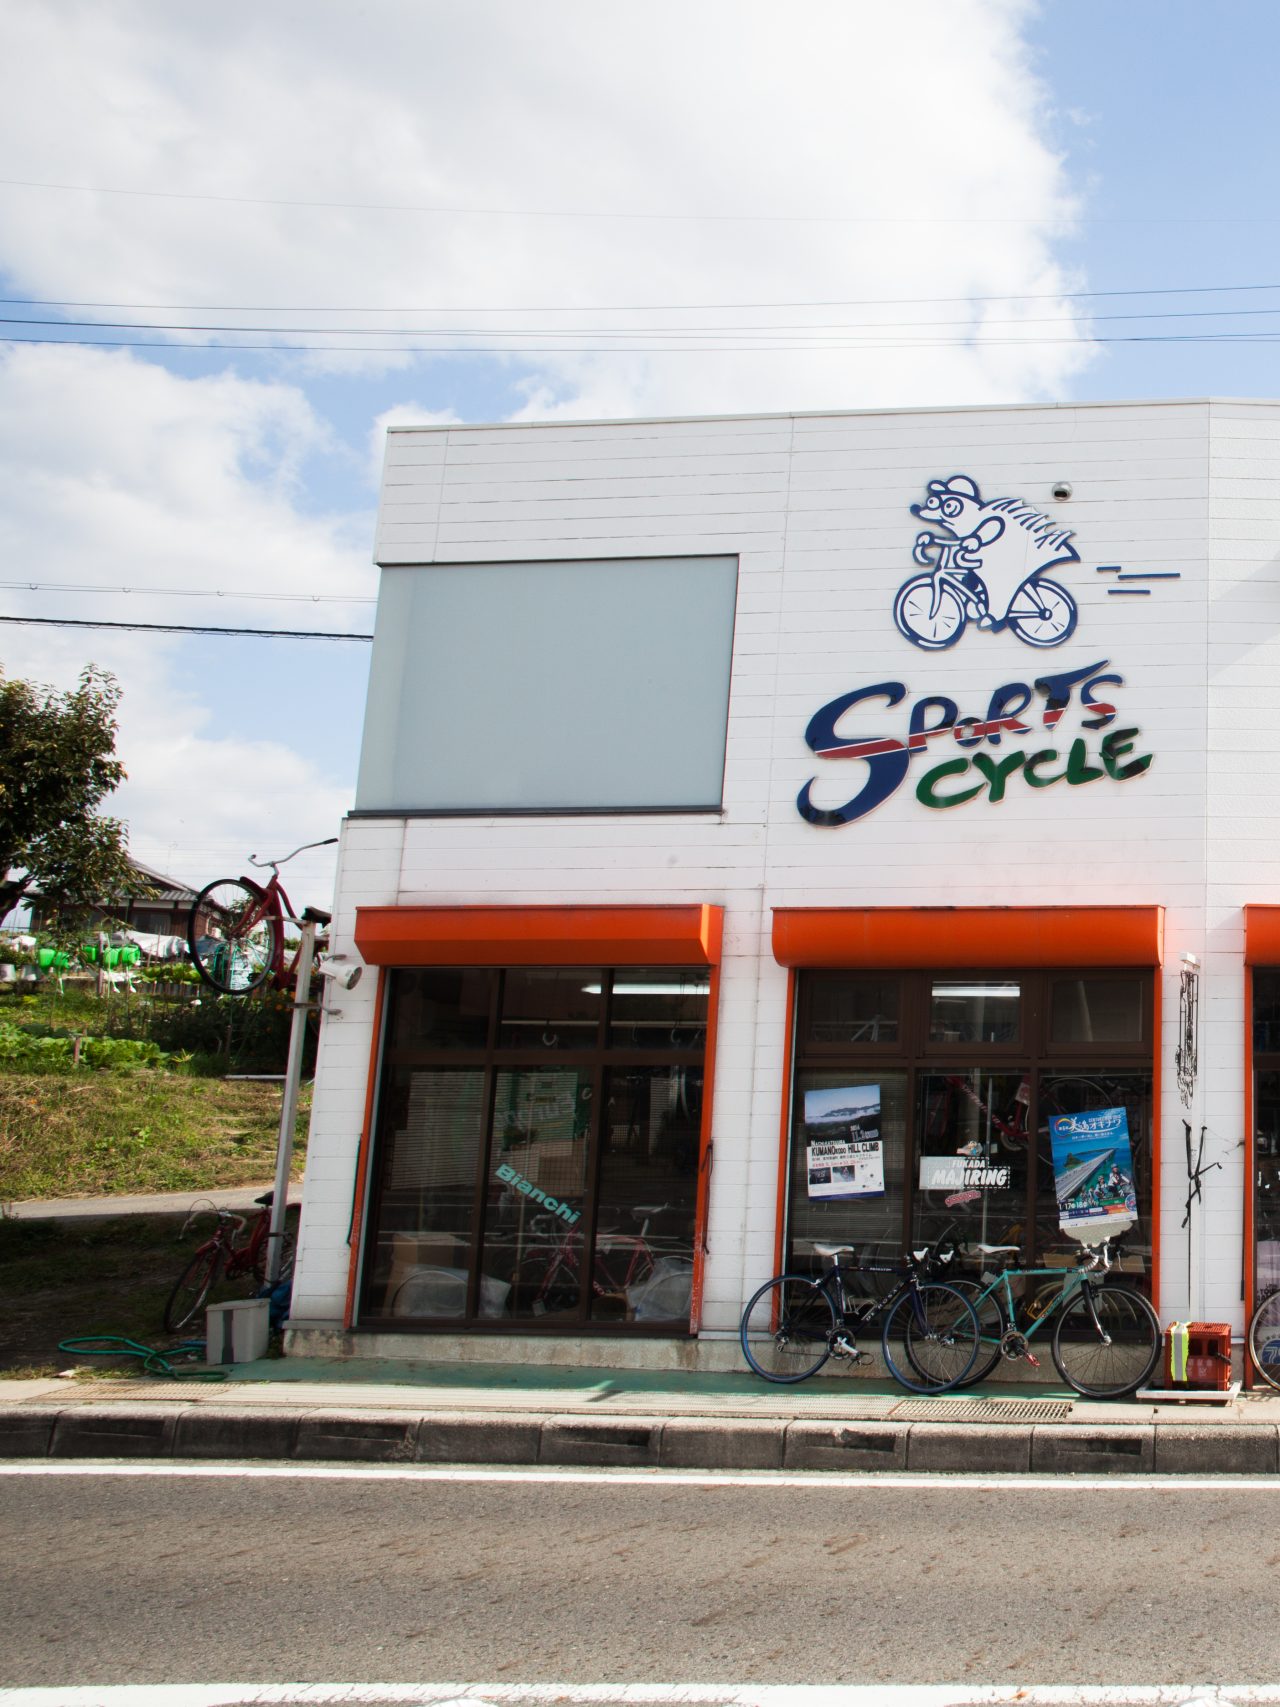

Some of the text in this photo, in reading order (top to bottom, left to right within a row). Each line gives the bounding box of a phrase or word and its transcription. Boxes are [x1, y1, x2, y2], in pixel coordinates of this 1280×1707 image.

[796, 659, 1126, 829] SPORTS
[915, 727, 1154, 811] CYCLE
[848, 1144, 861, 1153] HILL
[861, 1142, 879, 1152] CLIMB
[952, 1159, 985, 1168] FUKADA
[495, 1163, 582, 1225] Bianchi
[932, 1169, 1007, 1186] MAJIRING
